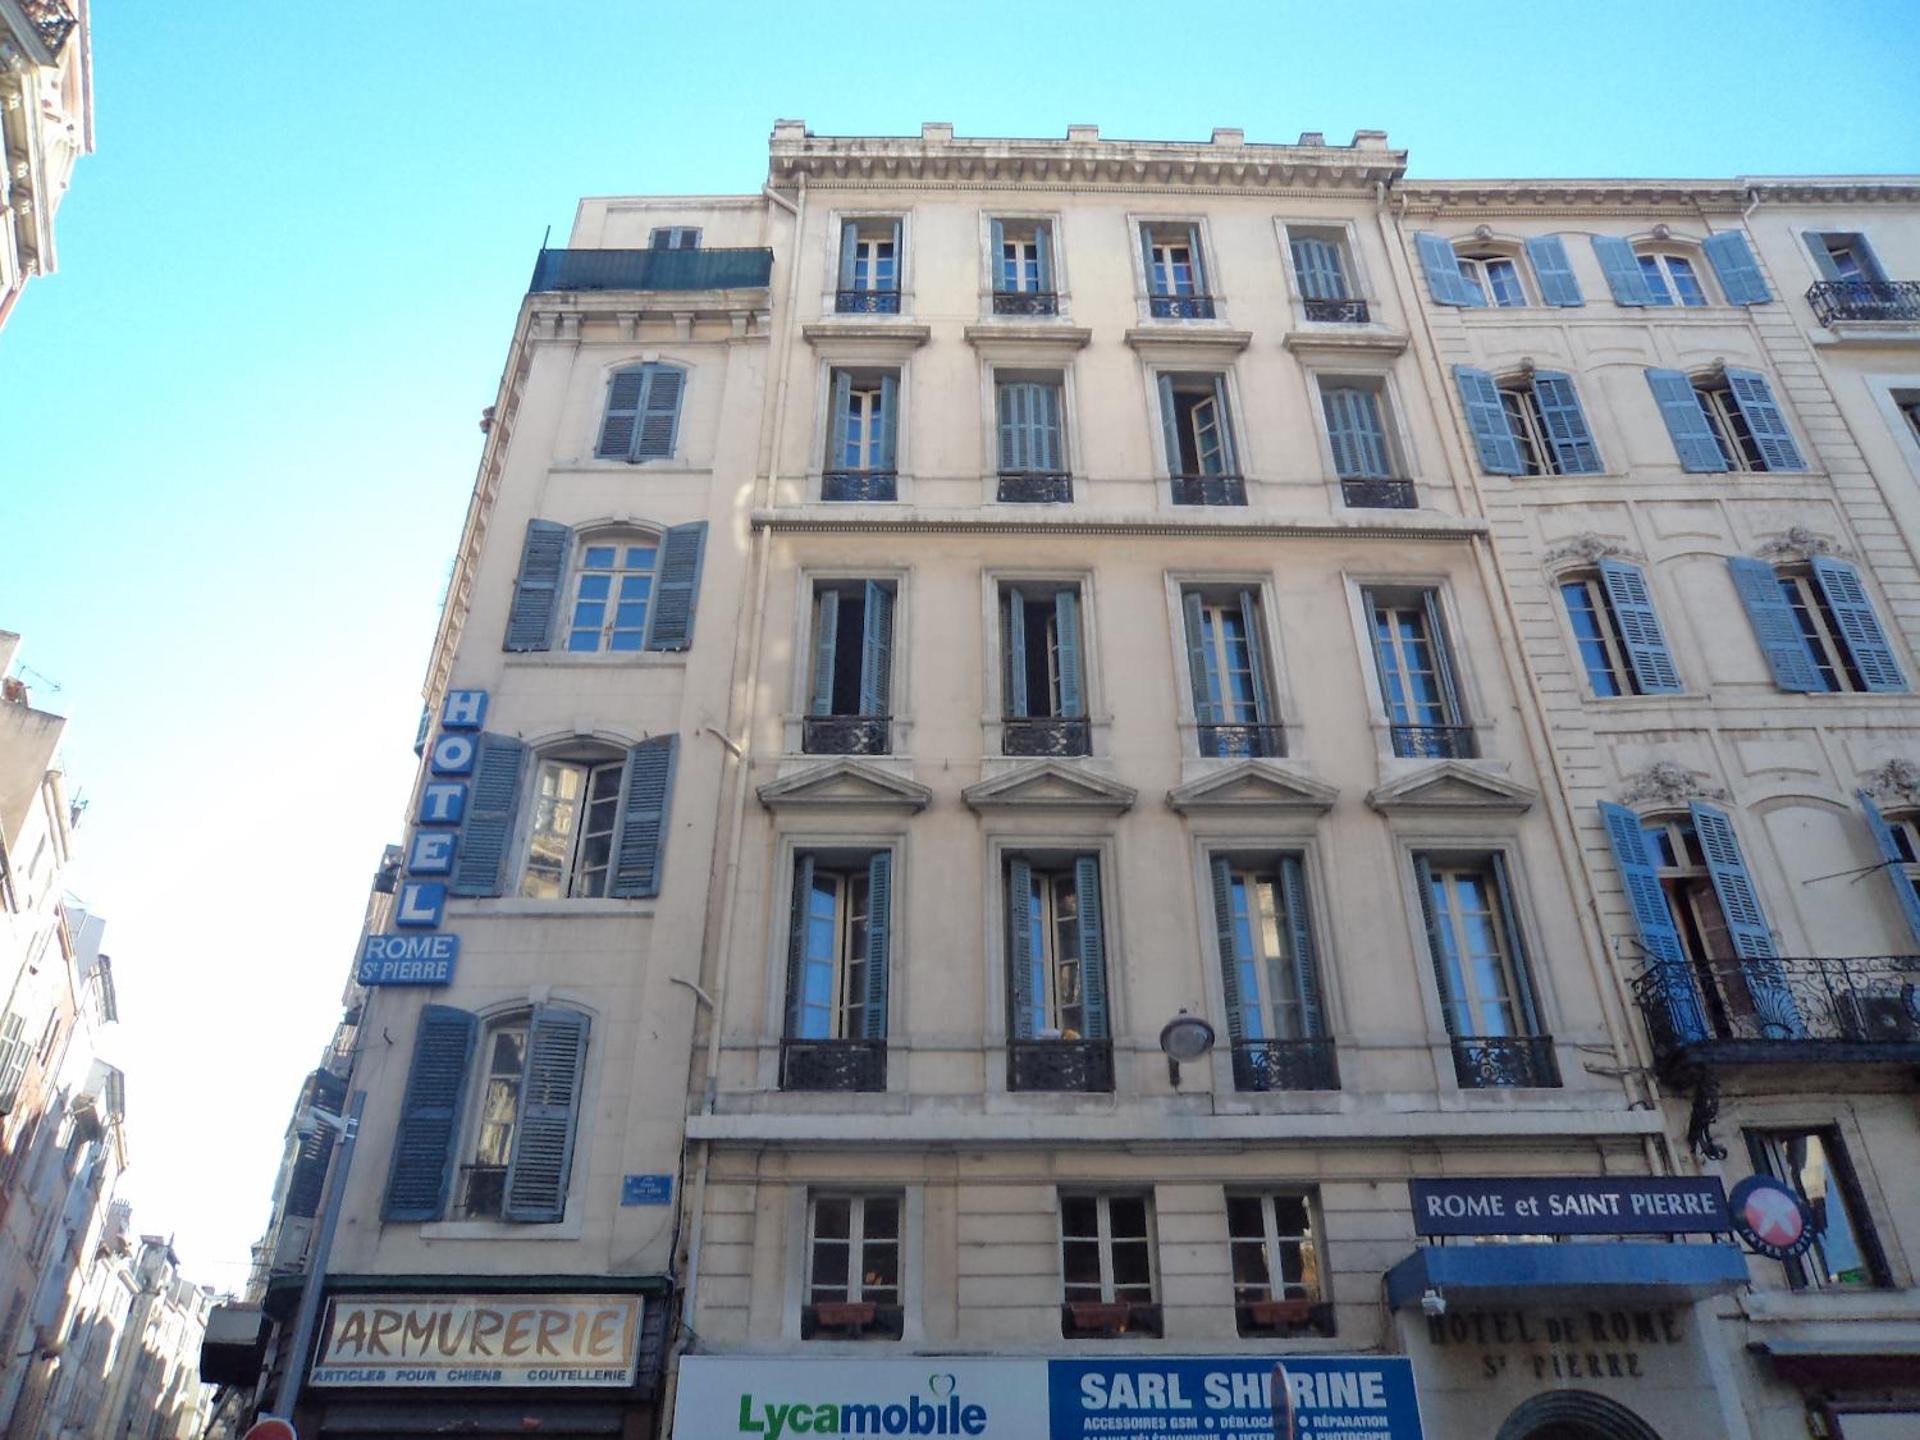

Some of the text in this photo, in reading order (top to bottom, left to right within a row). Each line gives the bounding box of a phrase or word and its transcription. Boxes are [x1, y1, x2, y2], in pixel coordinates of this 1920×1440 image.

[397, 690, 482, 921] HOTEL
[365, 936, 453, 959] ROME
[381, 961, 448, 979] PIERRE
[1426, 1192, 1718, 1218] ROME et SAINT PIERRE
[335, 1308, 620, 1358] ARMURERIE
[1546, 1316, 1579, 1344] DE
[1589, 1310, 1683, 1344] ROME
[312, 1368, 627, 1383] ARTICLES POUR CHIENS COUTELLERIE
[1535, 1352, 1644, 1379] PIERRE
[1080, 1372, 1193, 1410] SARL
[739, 1394, 987, 1440] Lycamobile
[1083, 1416, 1167, 1430] ACCESSOIRES
[1169, 1416, 1198, 1429] GSM
[1313, 1413, 1388, 1428] RÉPARATION
